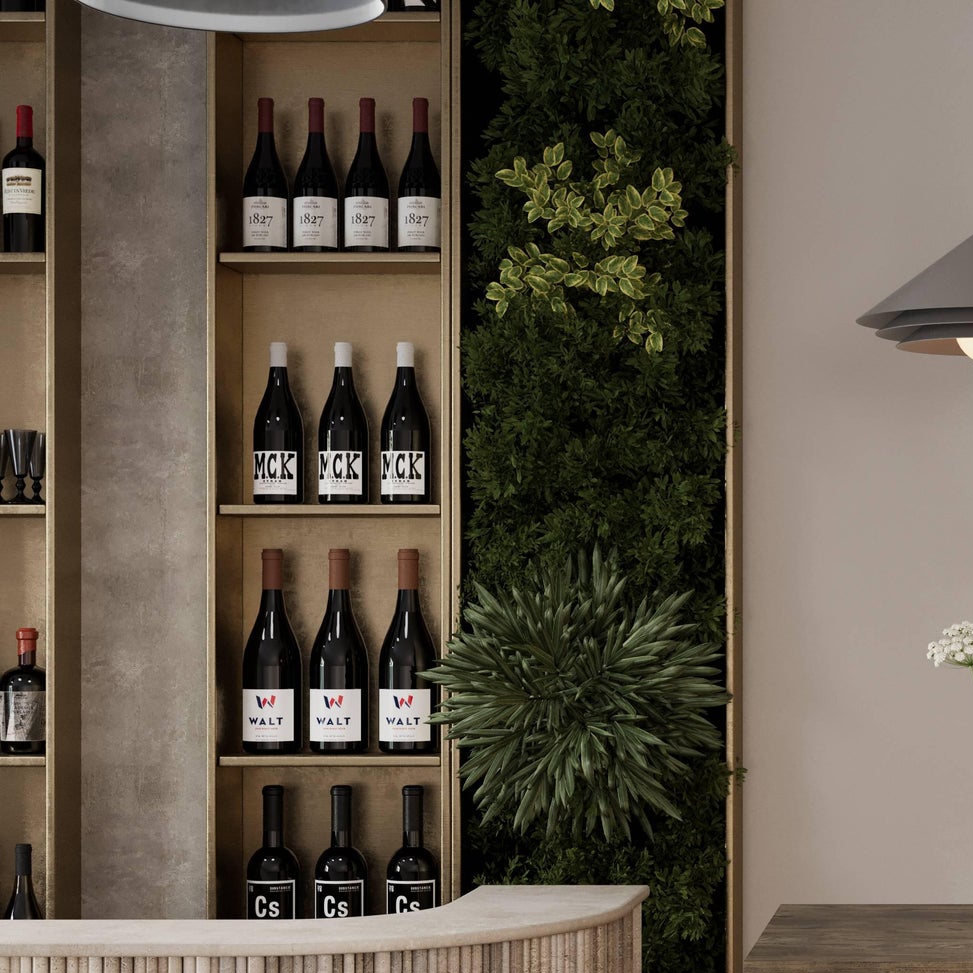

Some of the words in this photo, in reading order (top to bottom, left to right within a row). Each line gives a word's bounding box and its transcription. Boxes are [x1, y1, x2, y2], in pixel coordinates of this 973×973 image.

[249, 212, 273, 227] 1827
[300, 212, 324, 227] 1827
[351, 212, 375, 227] 1827
[405, 212, 429, 227] 1827
[249, 717, 283, 725] WALT
[316, 717, 350, 725] WALT
[386, 717, 420, 725] WALT
[255, 895, 280, 918] Cs
[323, 895, 349, 918] Cs
[395, 895, 421, 913] Cs
